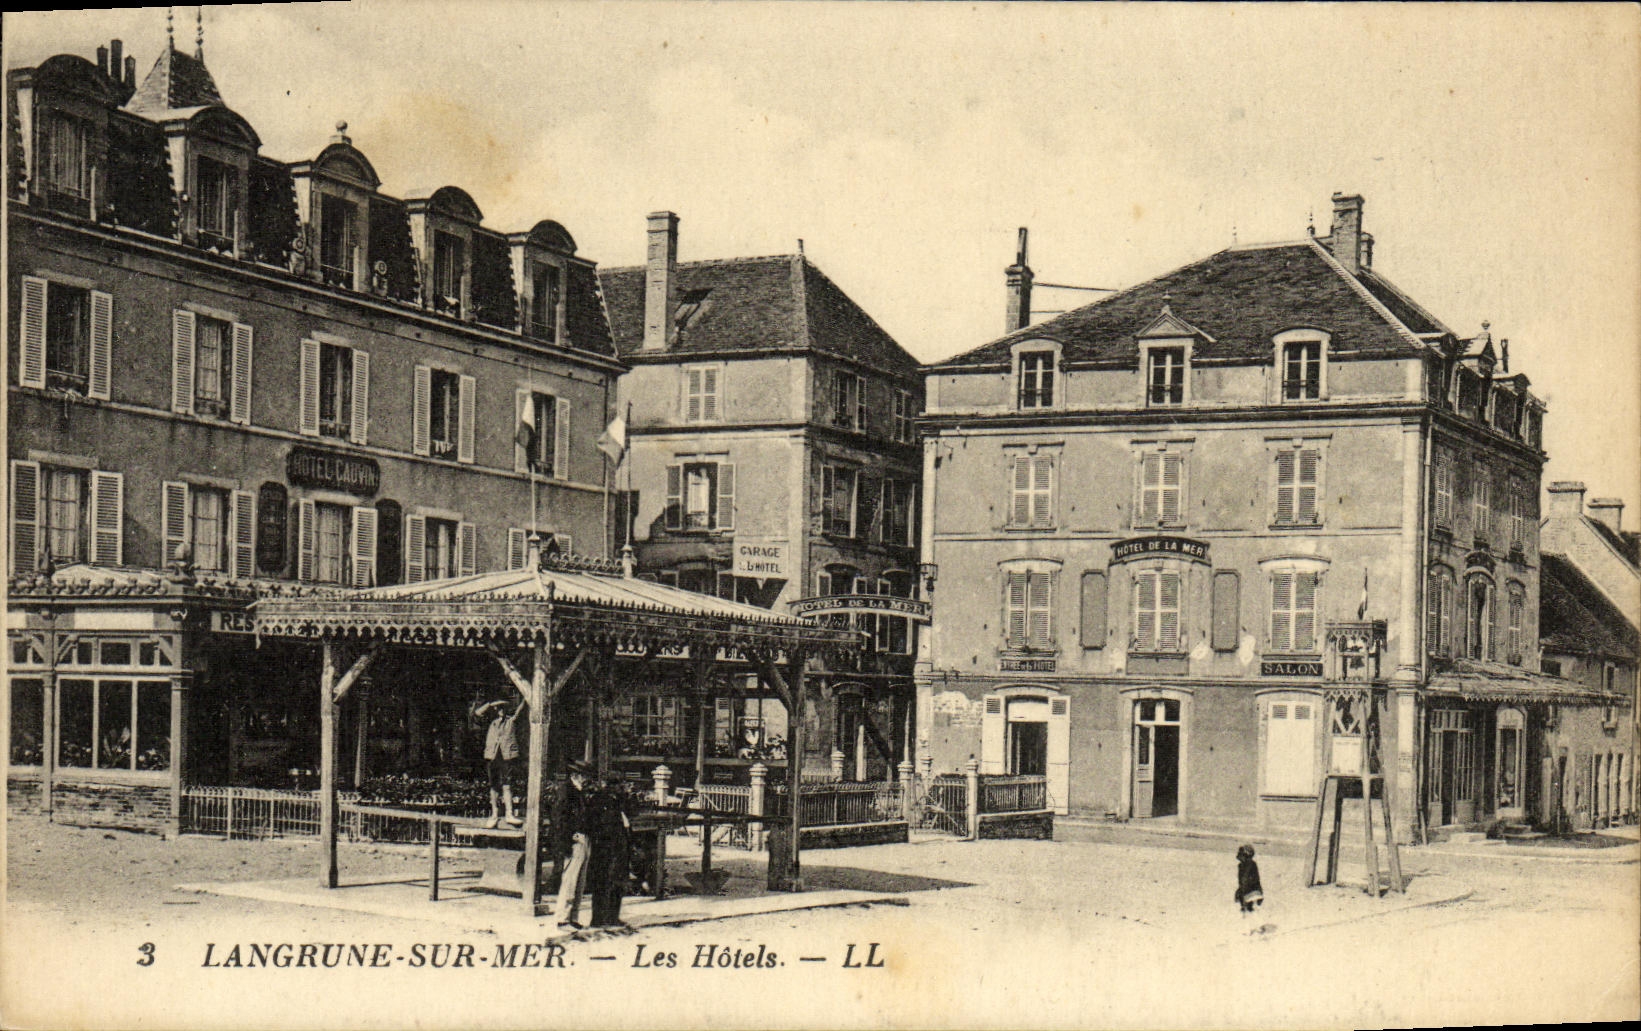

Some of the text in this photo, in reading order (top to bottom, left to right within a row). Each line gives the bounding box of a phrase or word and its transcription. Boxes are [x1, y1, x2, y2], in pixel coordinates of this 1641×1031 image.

[740, 545, 781, 558] GARAGE
[1148, 540, 1161, 551] DE
[1165, 541, 1177, 551] LA
[1182, 543, 1204, 557] MER
[848, 599, 864, 607] DE
[869, 599, 885, 609] LA
[889, 600, 923, 615] MER
[1264, 663, 1319, 675] SALON
